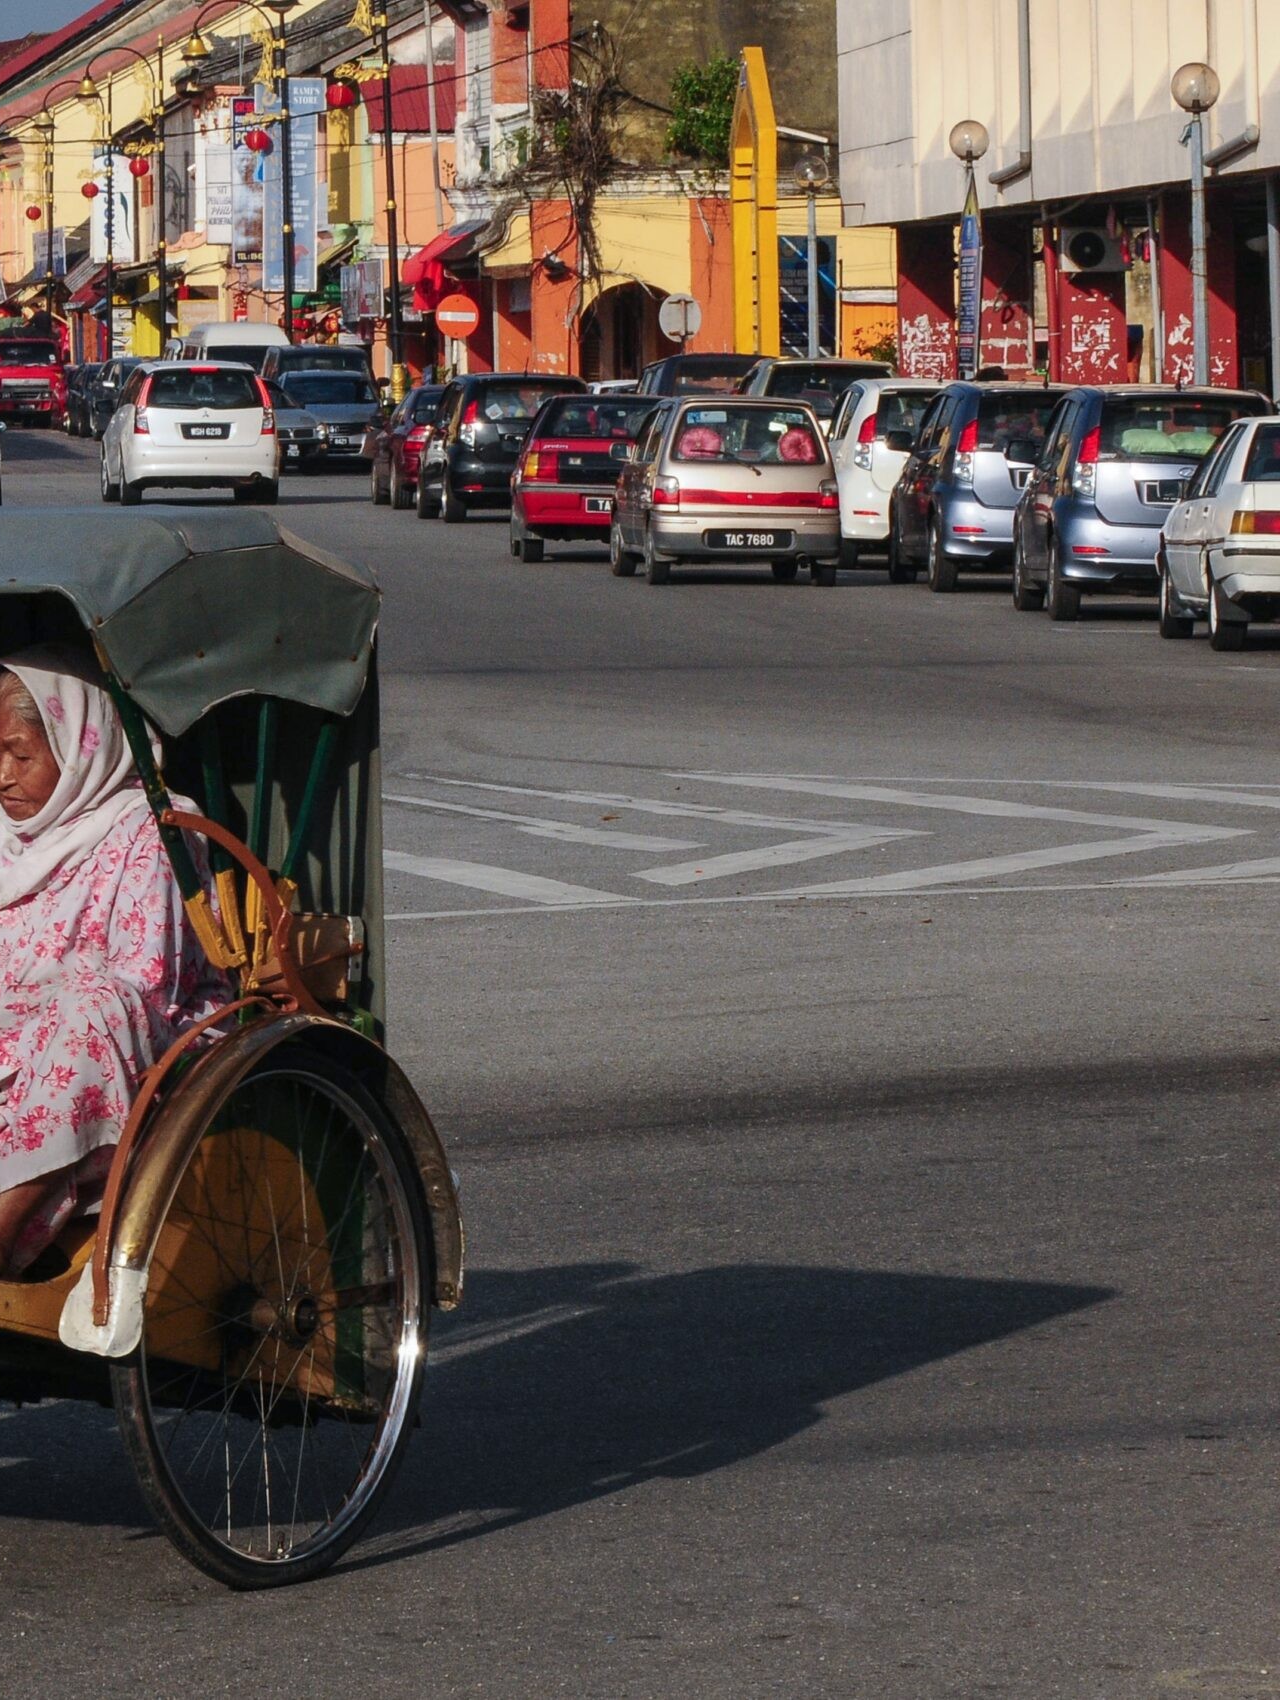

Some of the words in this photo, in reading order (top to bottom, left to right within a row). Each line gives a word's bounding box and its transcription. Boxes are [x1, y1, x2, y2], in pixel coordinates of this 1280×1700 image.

[293, 87, 320, 96] RAMI'S
[293, 96, 318, 104] STORE
[598, 500, 613, 511] TA
[725, 534, 744, 546] TAC
[746, 534, 775, 546] 7680
